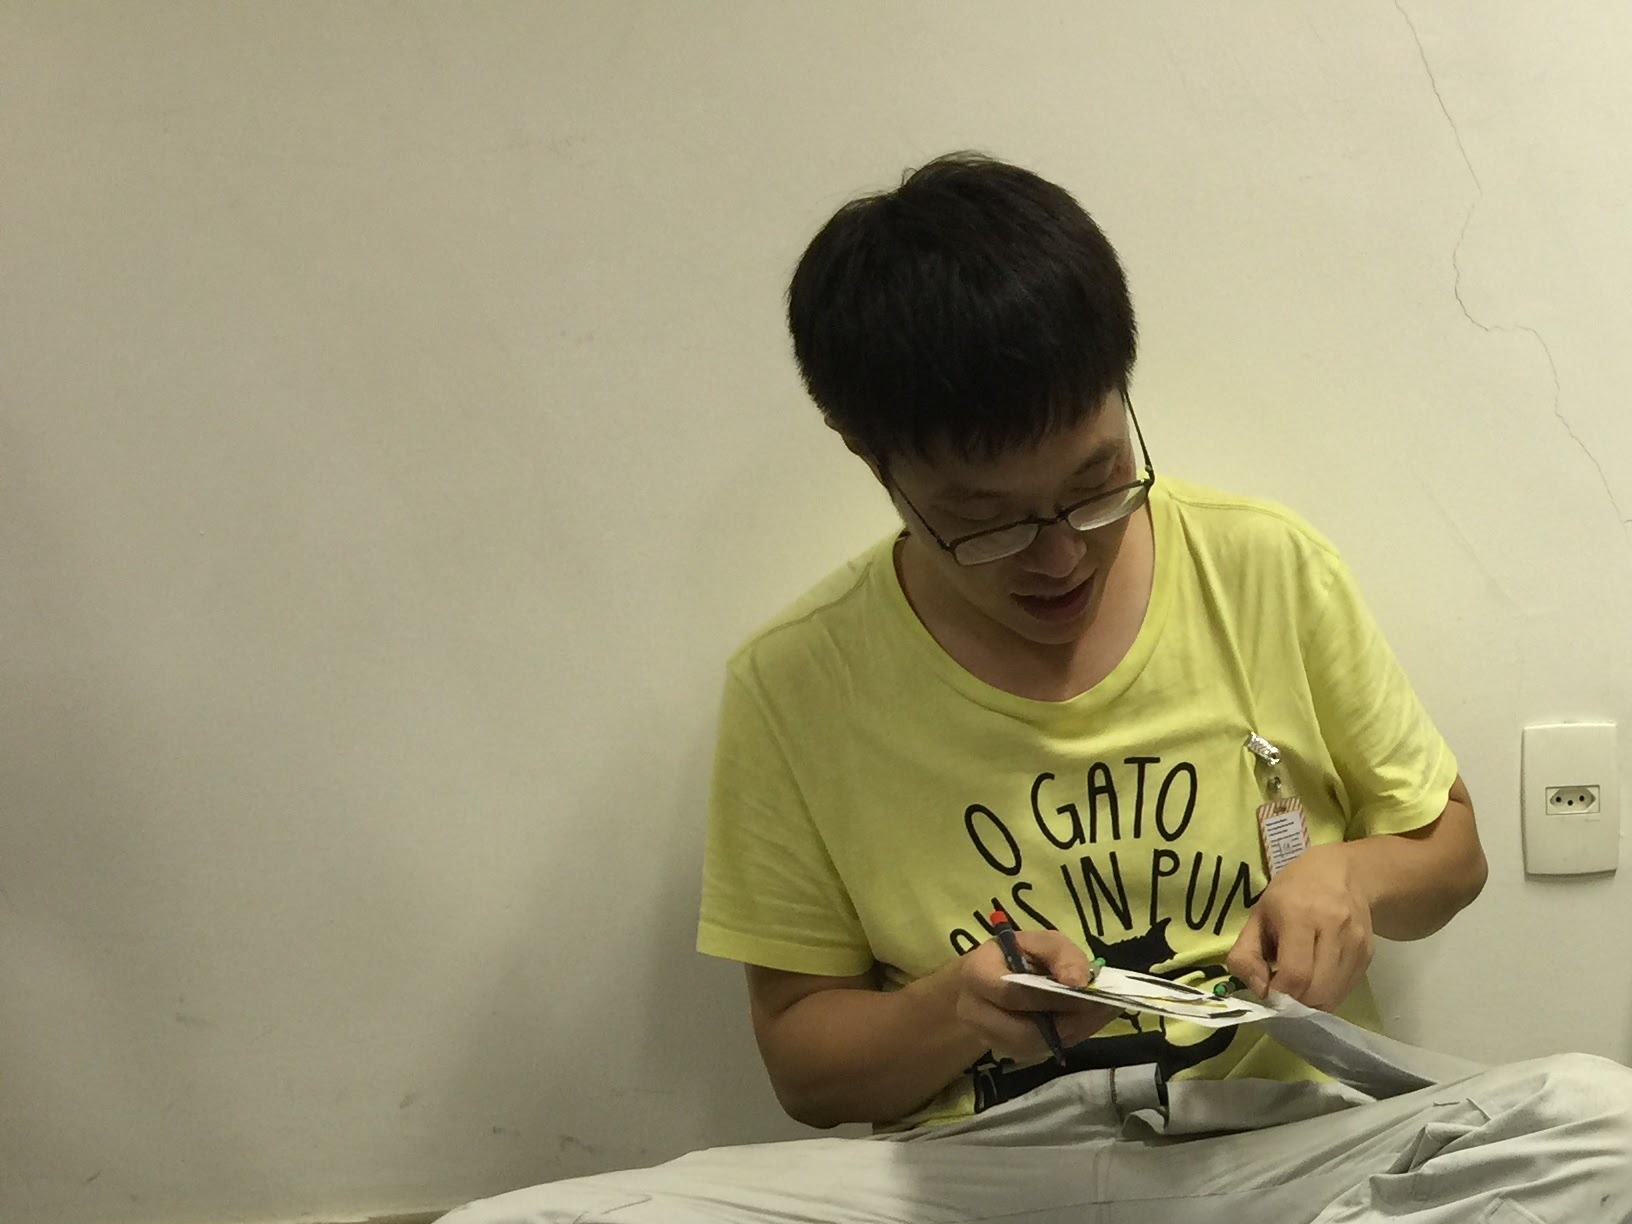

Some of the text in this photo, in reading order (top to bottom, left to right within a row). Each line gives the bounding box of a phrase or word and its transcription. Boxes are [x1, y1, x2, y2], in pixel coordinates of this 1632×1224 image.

[964, 756, 1198, 876] O GATO
[1060, 851, 1133, 937] IN
